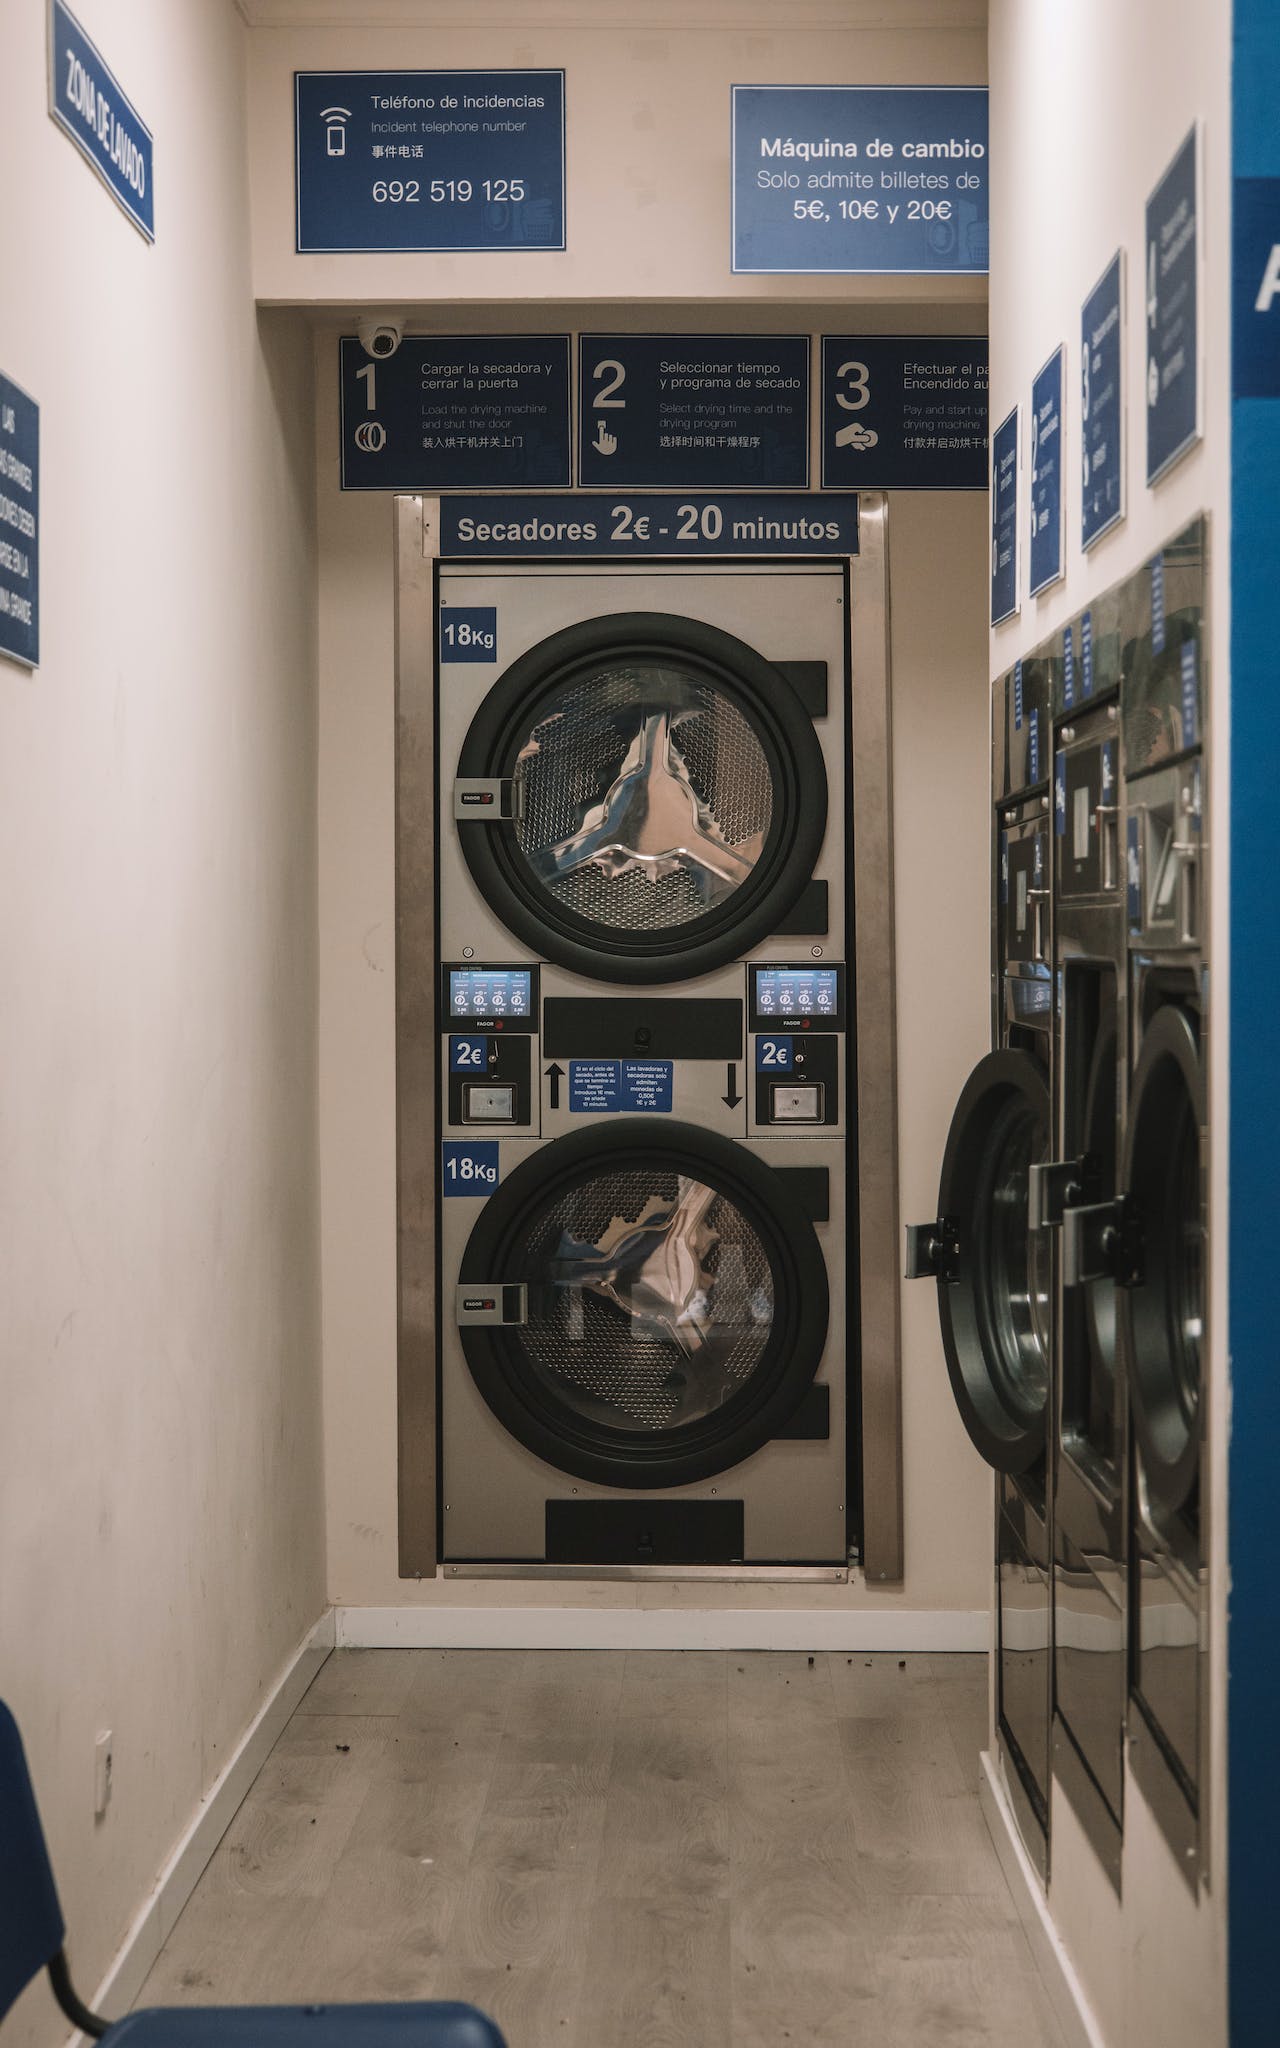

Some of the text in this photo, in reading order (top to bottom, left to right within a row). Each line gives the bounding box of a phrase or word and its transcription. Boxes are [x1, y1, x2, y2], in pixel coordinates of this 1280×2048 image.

[371, 94, 544, 109] Teléfono de incidencias
[66, 48, 145, 198] ZONA DE LAVADO
[371, 121, 526, 135] Incident telephone number
[371, 145, 423, 158] 事件电话
[761, 138, 984, 161] Máquina de cambio
[757, 171, 980, 188] Solo admite billetes de
[373, 180, 524, 202] 692 519 125
[794, 201, 952, 223] 5€, 10€ y 20€
[421, 363, 552, 376] Cargar la secadora y
[660, 361, 780, 375] Seleccionar tiempo
[904, 363, 957, 375] Efectuar
[961, 363, 972, 375] el
[356, 363, 375, 410] 1
[421, 378, 518, 390] cerrar la puerta
[593, 360, 626, 408] 2
[660, 377, 800, 390] y programa de secado
[835, 362, 870, 411] 3
[904, 378, 969, 389] Encendido
[1083, 342, 1089, 421] 3
[421, 404, 546, 416] Load the drying machine
[659, 403, 792, 415] Select drying time and the
[904, 405, 987, 417] Pay and start up
[422, 419, 512, 429] and shut the door
[660, 418, 737, 430] drying program
[904, 420, 980, 431] drying machine
[1032, 414, 1038, 484] 2
[458, 518, 597, 541] Secadores
[610, 505, 650, 540] 2€
[676, 505, 723, 540] 20
[733, 518, 840, 540] minutos
[444, 624, 494, 649] 18Kg
[456, 1042, 482, 1064] 2€
[762, 1042, 788, 1064] 2€
[447, 1158, 496, 1182] 18Kg
